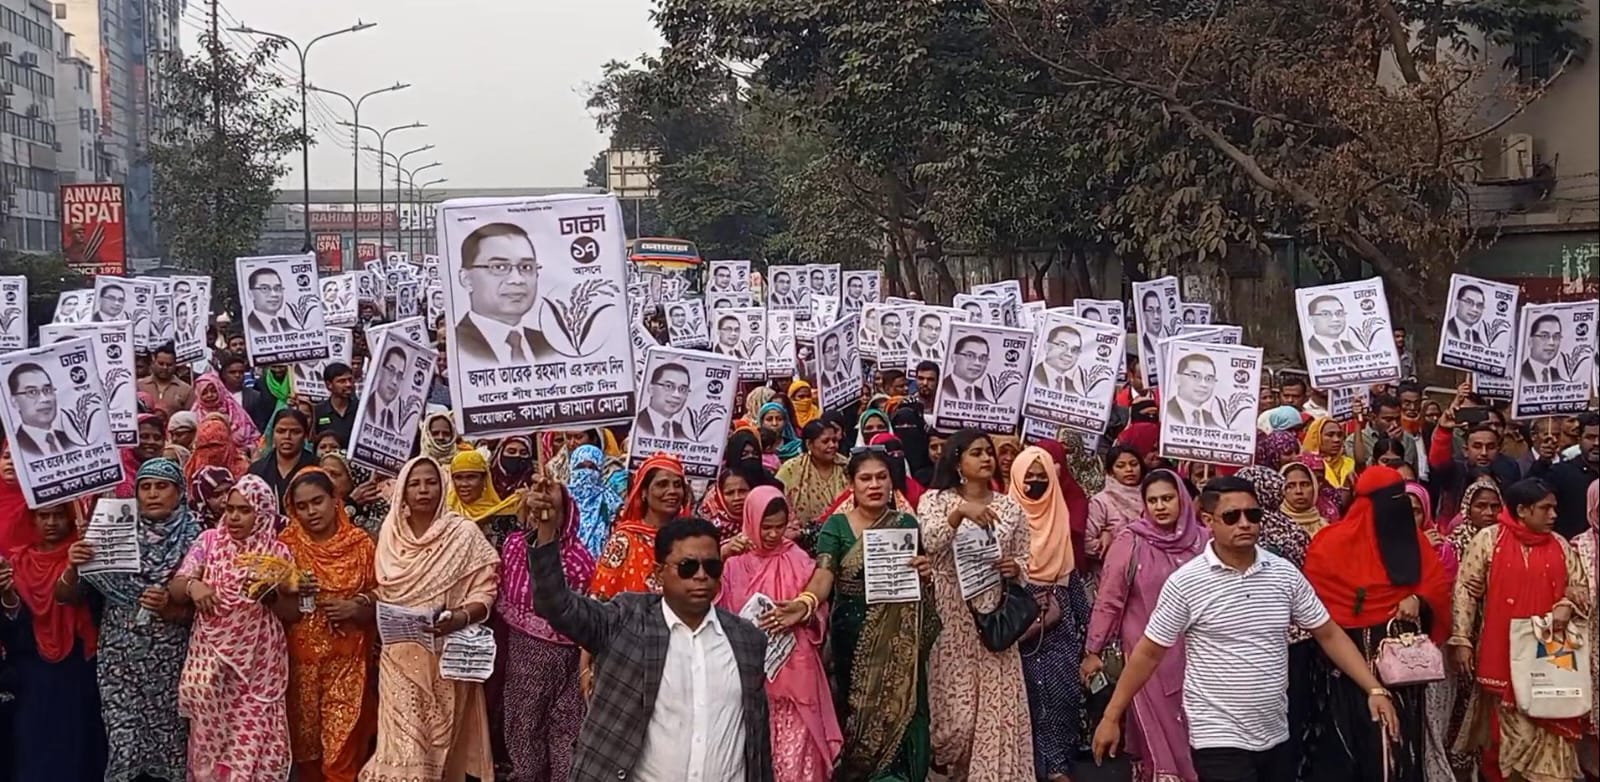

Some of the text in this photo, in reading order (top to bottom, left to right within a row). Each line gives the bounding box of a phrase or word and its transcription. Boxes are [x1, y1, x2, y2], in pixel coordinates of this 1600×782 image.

[64, 187, 122, 202] ANWAR
[64, 202, 122, 224] ISPAT
[311, 213, 353, 222] RAHIM
[558, 214, 606, 236] ঢাকা
[572, 242, 598, 258] ১৭
[100, 266, 122, 274] 1978
[572, 265, 602, 275] আসনে
[101, 332, 127, 344] ঢাকা
[59, 350, 89, 367] ঢাকা
[468, 369, 496, 387] জনাব
[498, 365, 532, 384] তারেক
[535, 362, 567, 382] রহমান
[570, 364, 582, 377] এর
[705, 367, 731, 380] ঢাকা
[478, 391, 508, 403] ধানের
[512, 386, 532, 399] শীষ
[570, 380, 594, 394] ভোট
[598, 378, 617, 391] দিন
[518, 402, 556, 421] কামাল
[559, 399, 595, 416] জামান
